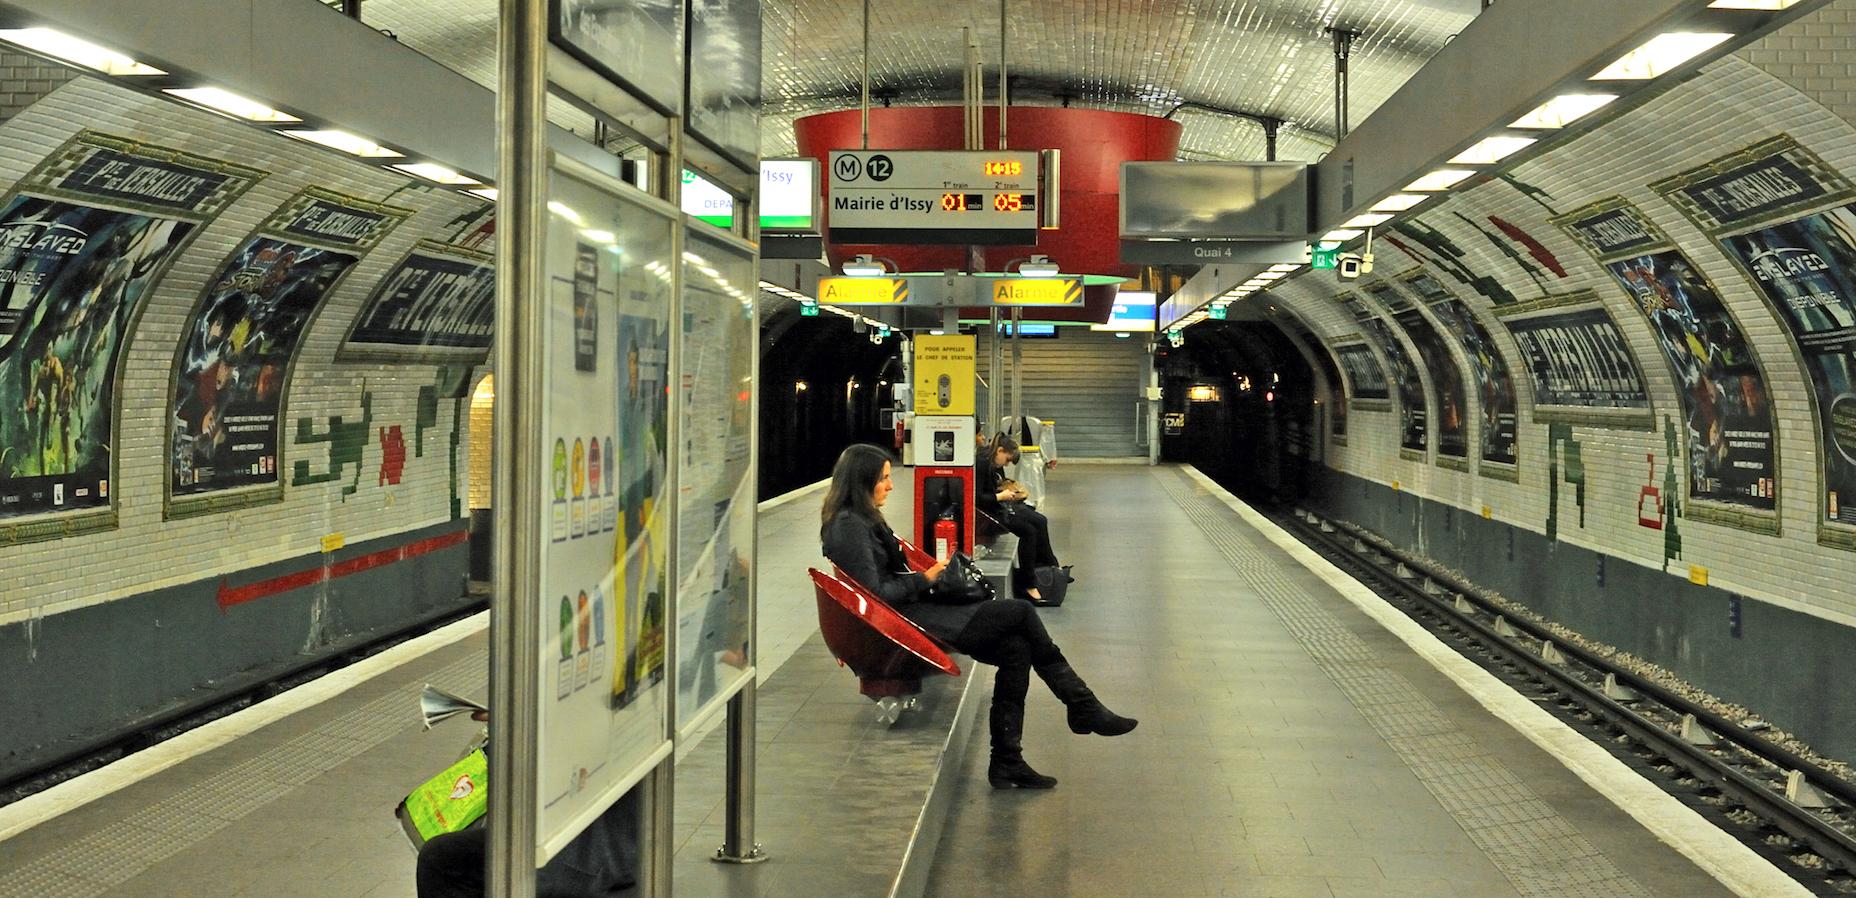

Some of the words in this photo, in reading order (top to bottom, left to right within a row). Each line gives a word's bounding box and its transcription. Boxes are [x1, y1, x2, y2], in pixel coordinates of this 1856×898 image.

[763, 169, 794, 185] 'Issy
[869, 160, 890, 177] 12
[117, 164, 206, 202] VERSAILLES
[1719, 166, 1804, 209] VERSAILLES
[704, 199, 732, 209] DEPA
[835, 196, 885, 211] Mairie
[890, 193, 934, 213] d'Issy
[942, 194, 967, 212] 01
[967, 202, 983, 210] min
[994, 194, 1022, 212] 05
[1020, 202, 1035, 210] min
[1194, 247, 1223, 259] Quai
[1224, 247, 1233, 258] 4
[1753, 253, 1829, 281] ENSLAVED
[0, 268, 47, 286] ONIBLE
[826, 283, 888, 300] Ale
[996, 284, 1058, 300] Alarme
[1532, 323, 1640, 392] VERSAILLES
